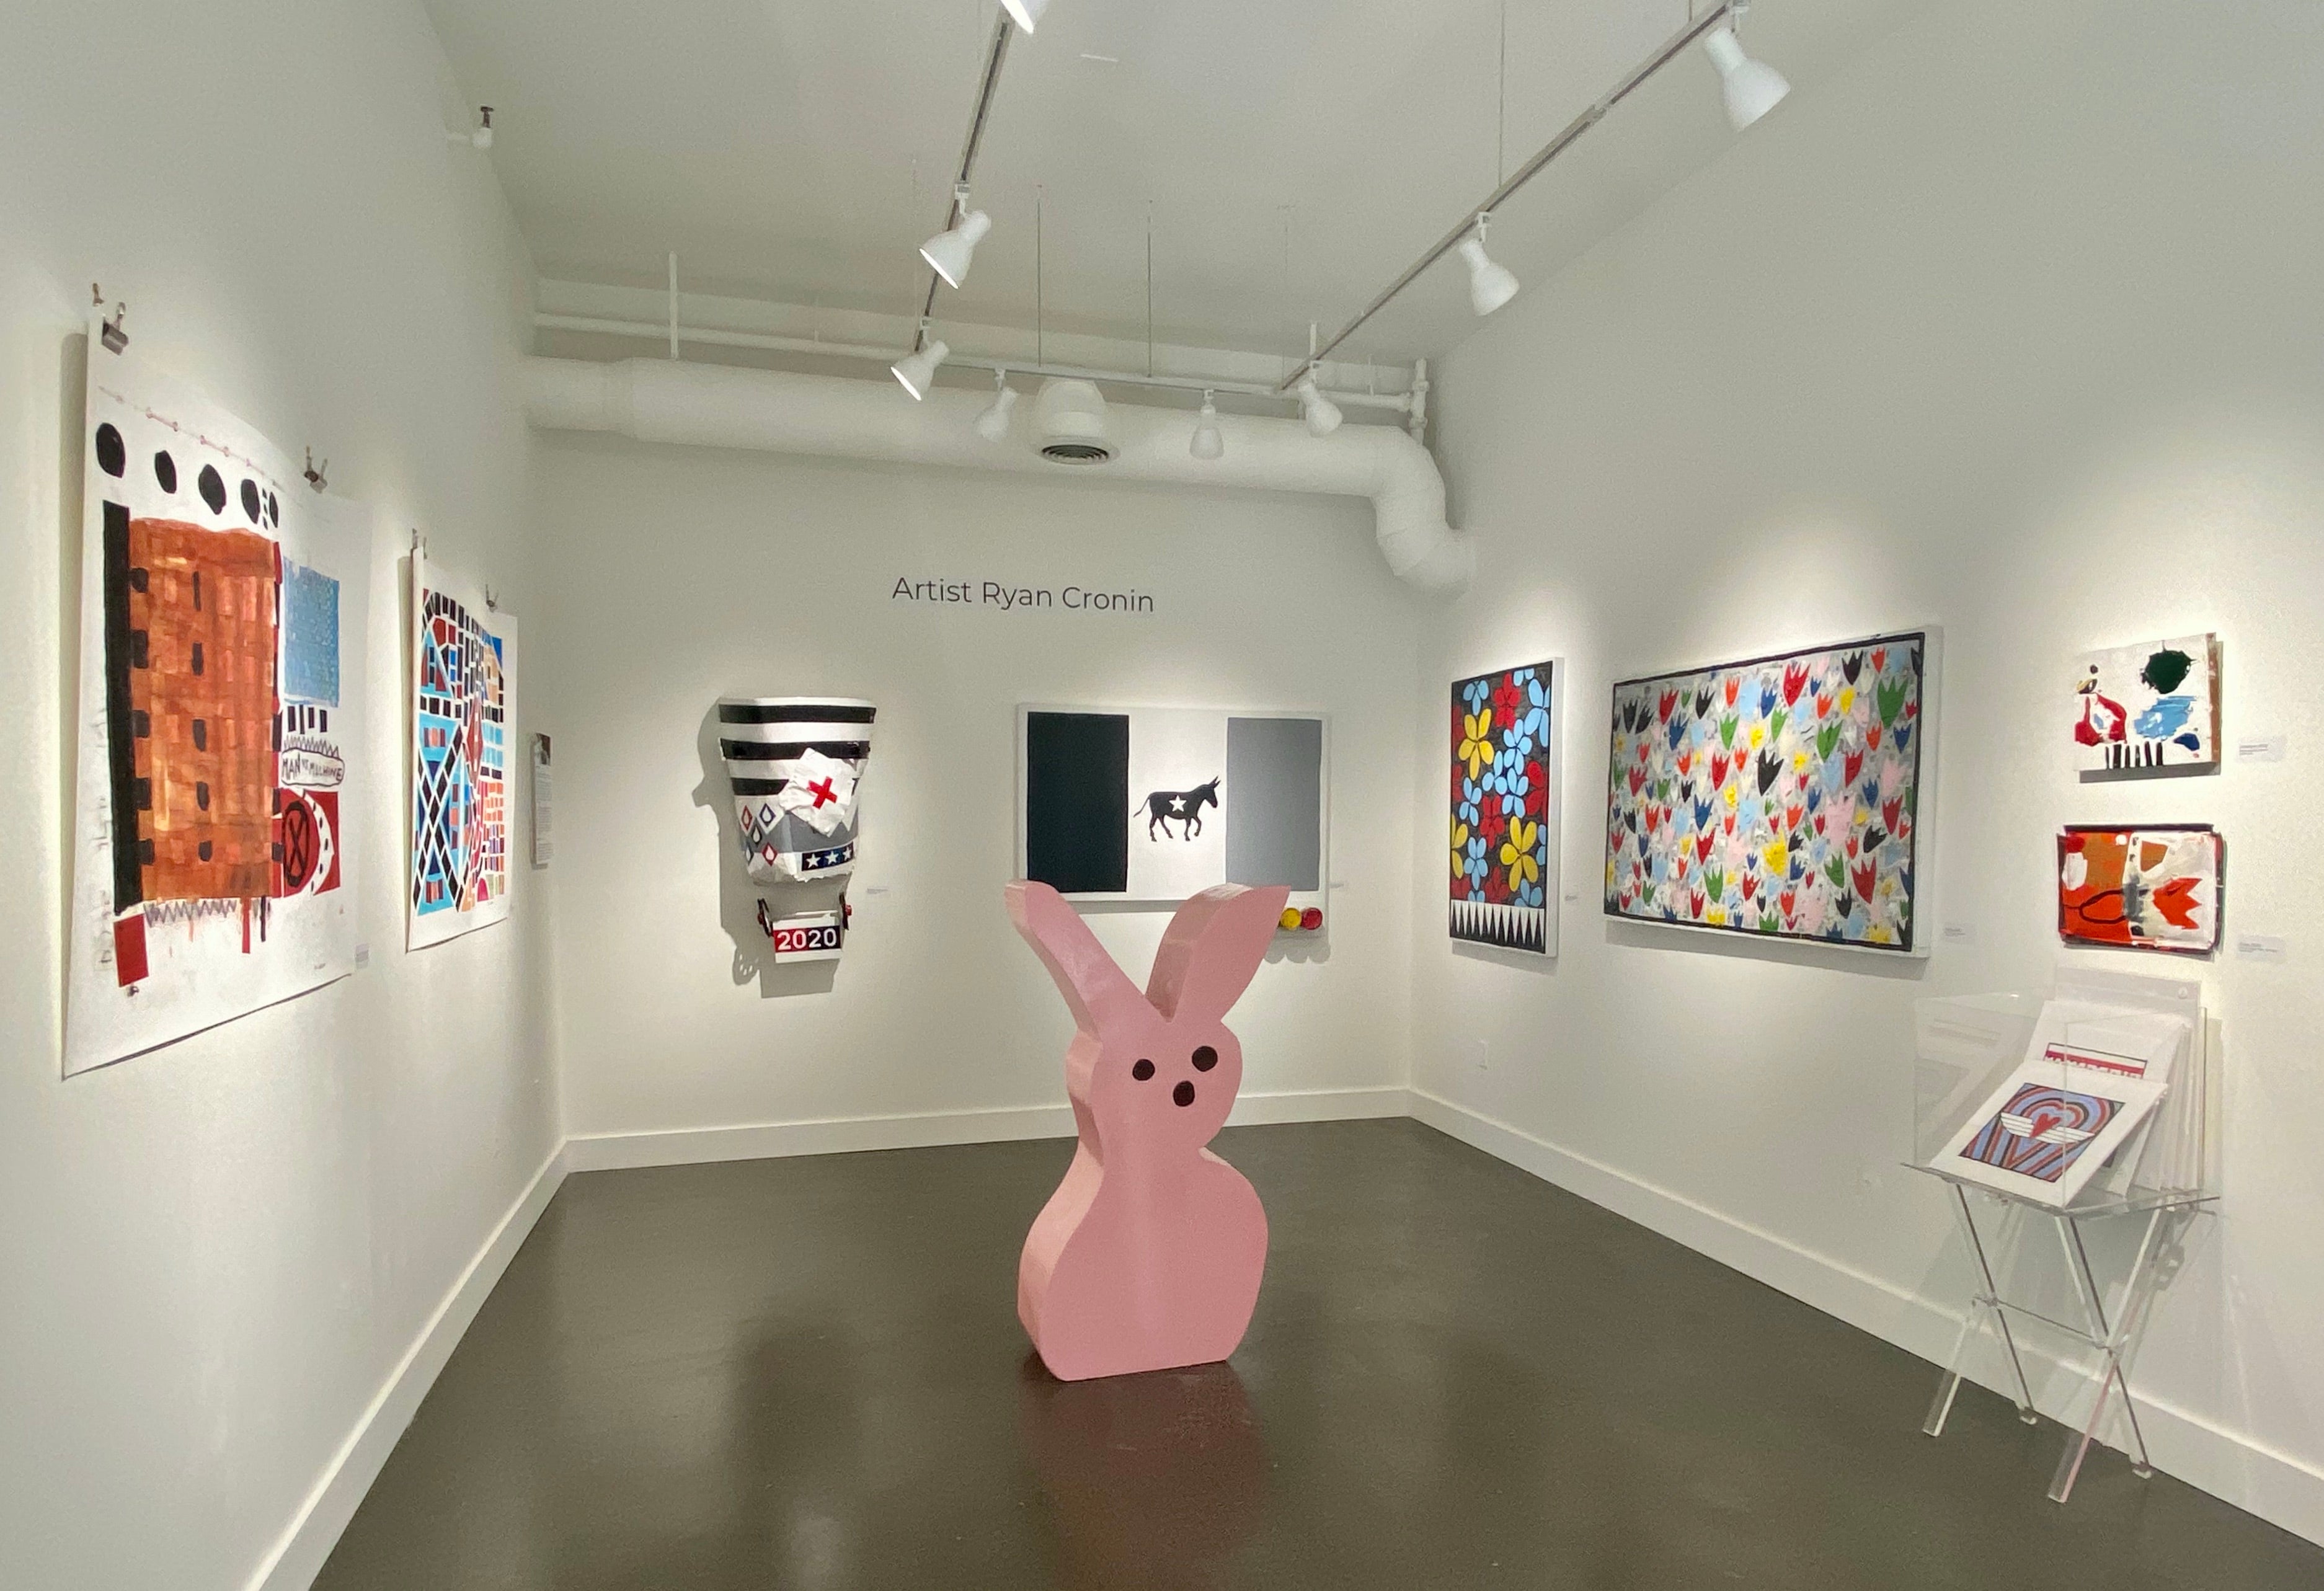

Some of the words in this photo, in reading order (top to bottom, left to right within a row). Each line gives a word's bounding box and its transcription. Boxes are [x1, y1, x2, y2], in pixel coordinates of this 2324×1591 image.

[892, 577, 972, 603] Artist
[982, 581, 1052, 610] Ryan
[1062, 586, 1154, 612] Cronin
[282, 751, 300, 780] MAN
[776, 928, 837, 951] 2020
